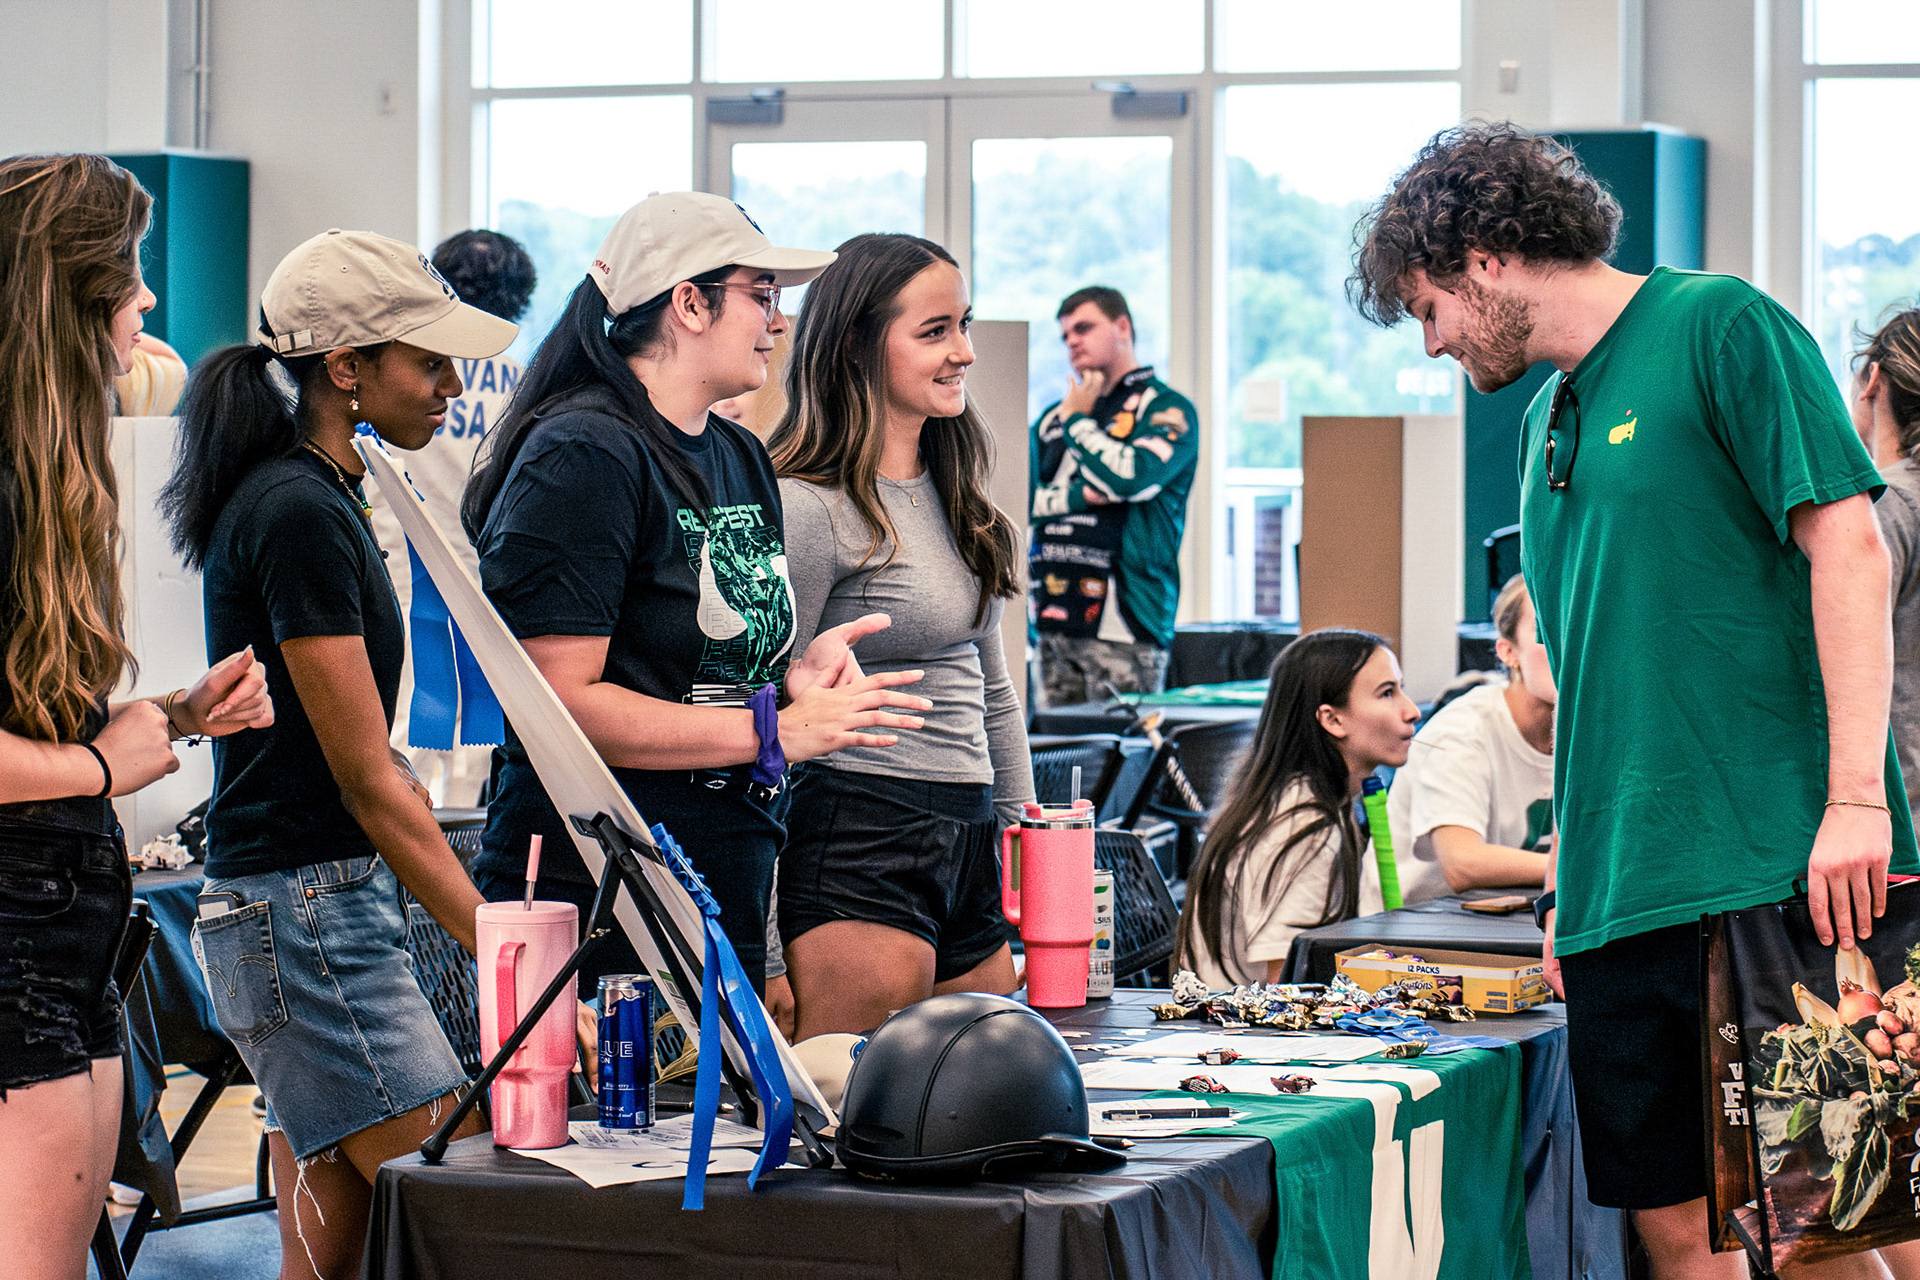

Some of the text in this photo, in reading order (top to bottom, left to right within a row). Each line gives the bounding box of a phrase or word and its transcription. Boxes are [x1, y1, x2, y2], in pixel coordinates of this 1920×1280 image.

[435, 399, 485, 439] SA
[1407, 965, 1440, 975] 12 PACKS
